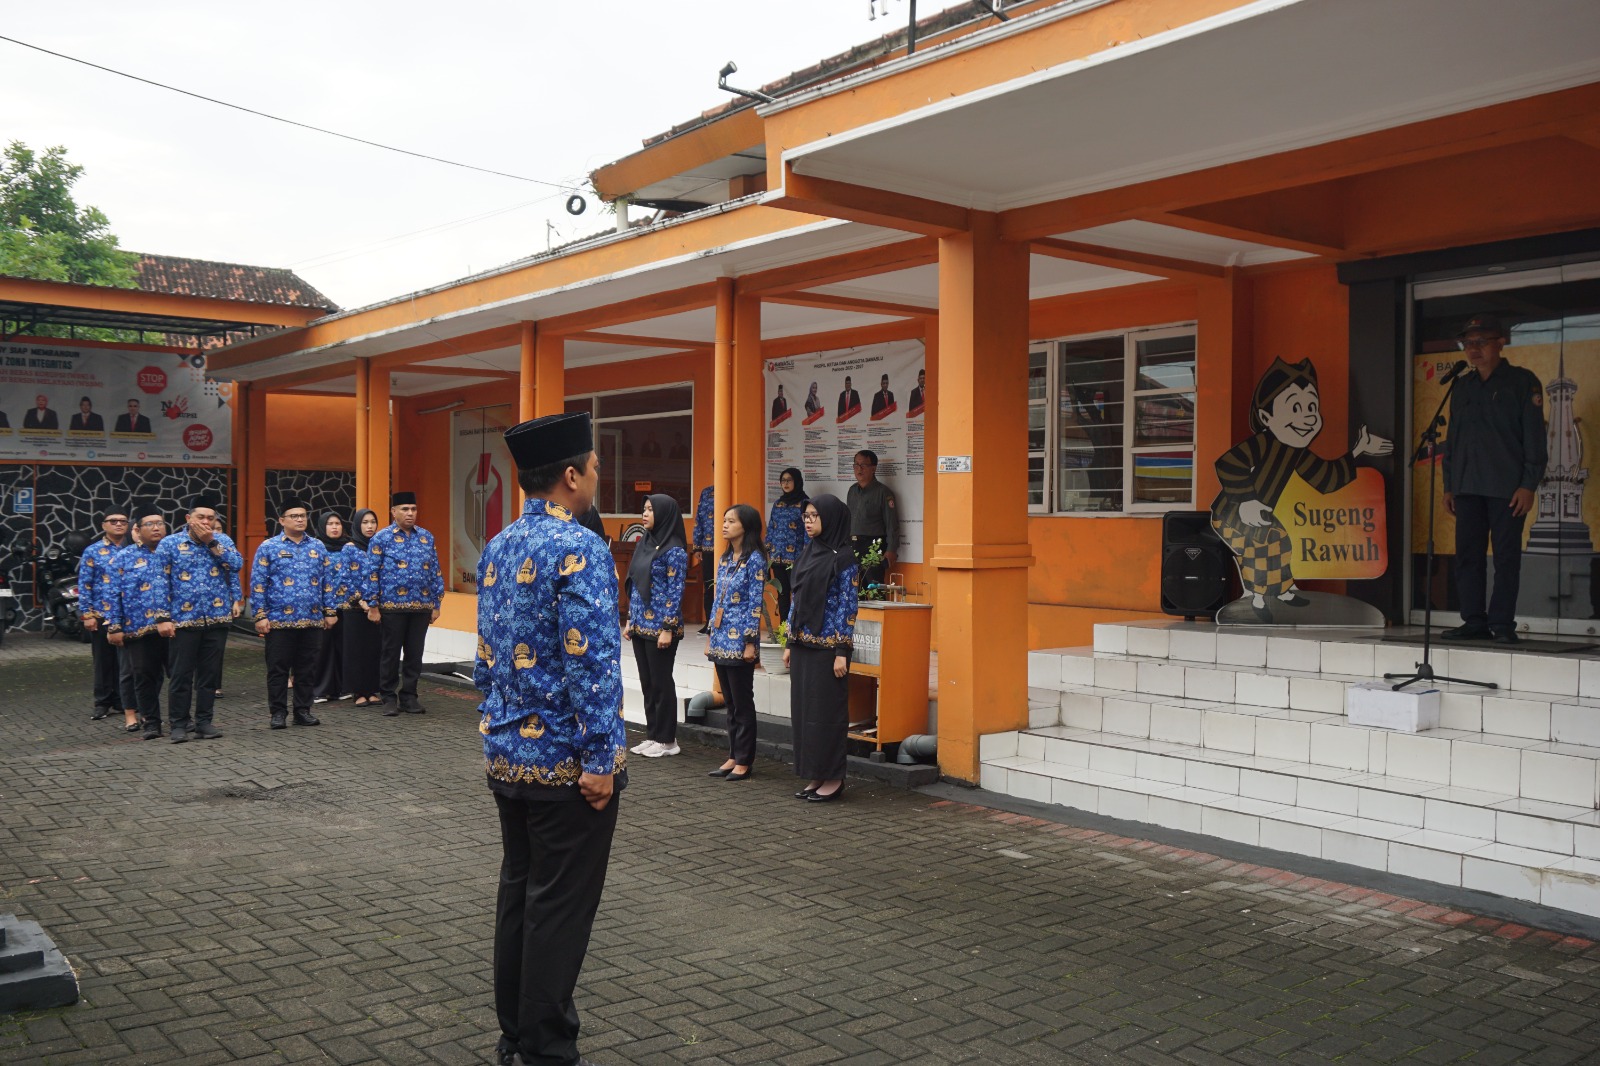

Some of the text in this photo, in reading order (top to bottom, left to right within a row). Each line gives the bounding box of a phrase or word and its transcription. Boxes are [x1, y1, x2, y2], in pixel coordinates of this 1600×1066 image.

[5, 357, 26, 367] ZONA
[29, 358, 73, 369] INTEGRITAS
[140, 373, 164, 383] STOP
[17, 490, 30, 504] P
[1294, 502, 1375, 533] Sugeng
[1300, 537, 1379, 562] Rawuh
